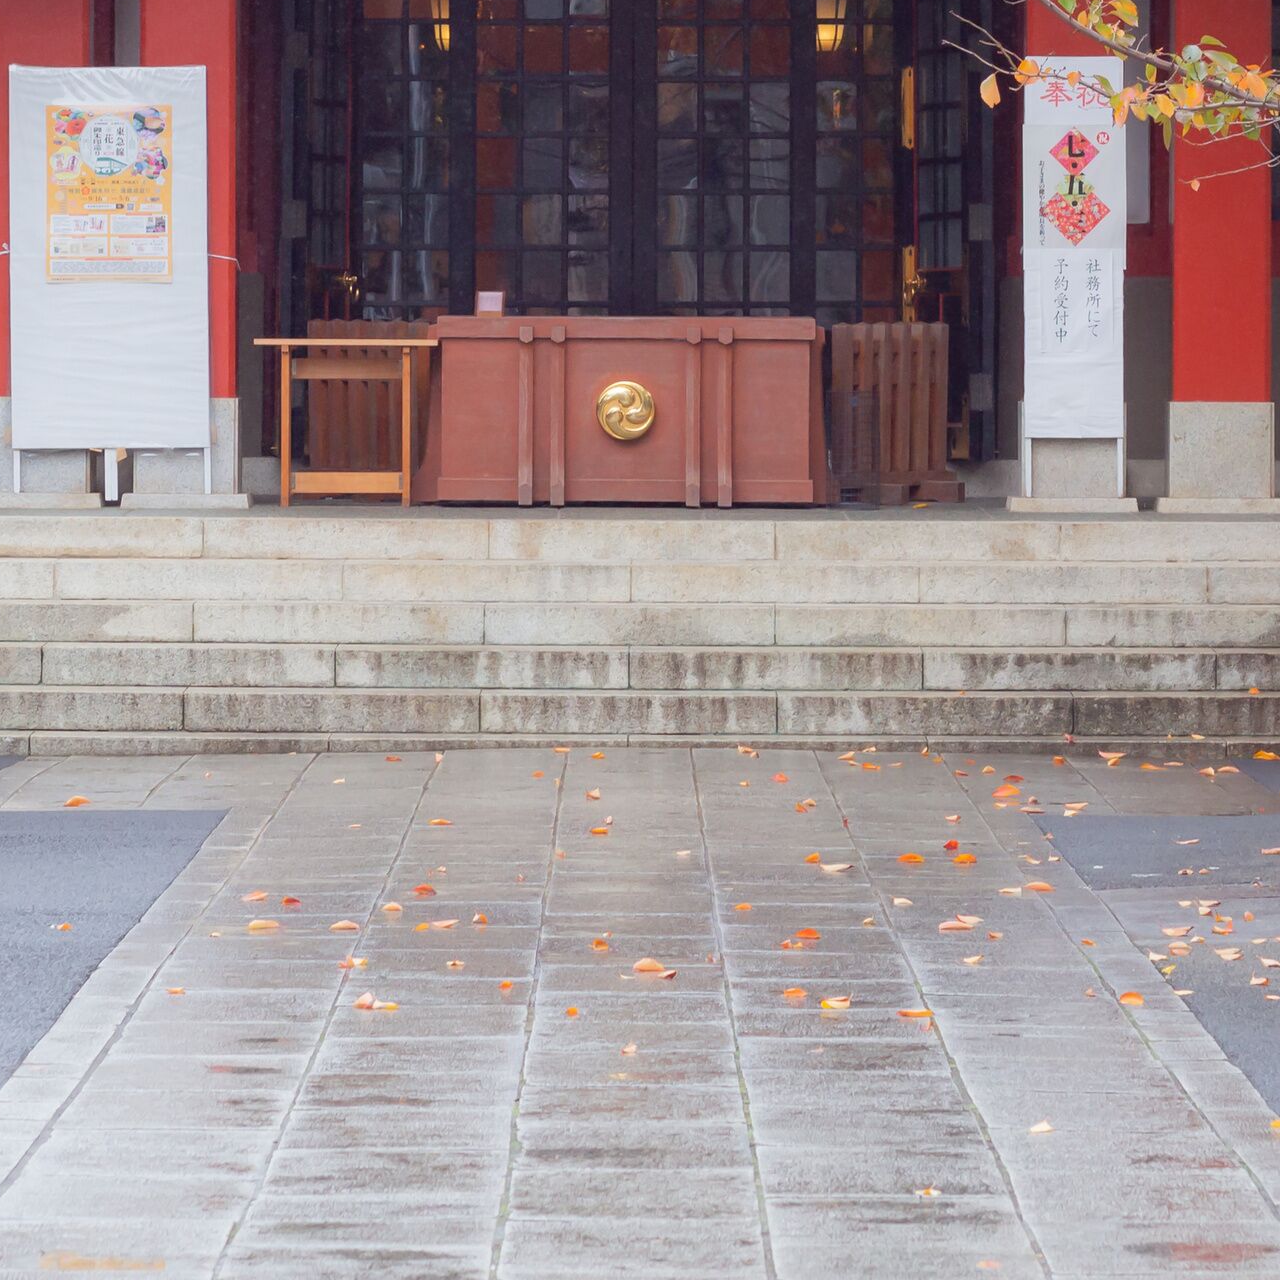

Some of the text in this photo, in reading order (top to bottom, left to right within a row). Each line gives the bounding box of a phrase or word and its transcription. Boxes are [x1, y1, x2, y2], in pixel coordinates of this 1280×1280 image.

[1039, 81, 1111, 108] 奉祝
[1053, 258, 1069, 343] 予約受付中
[1086, 258, 1102, 337] 社務所にて
